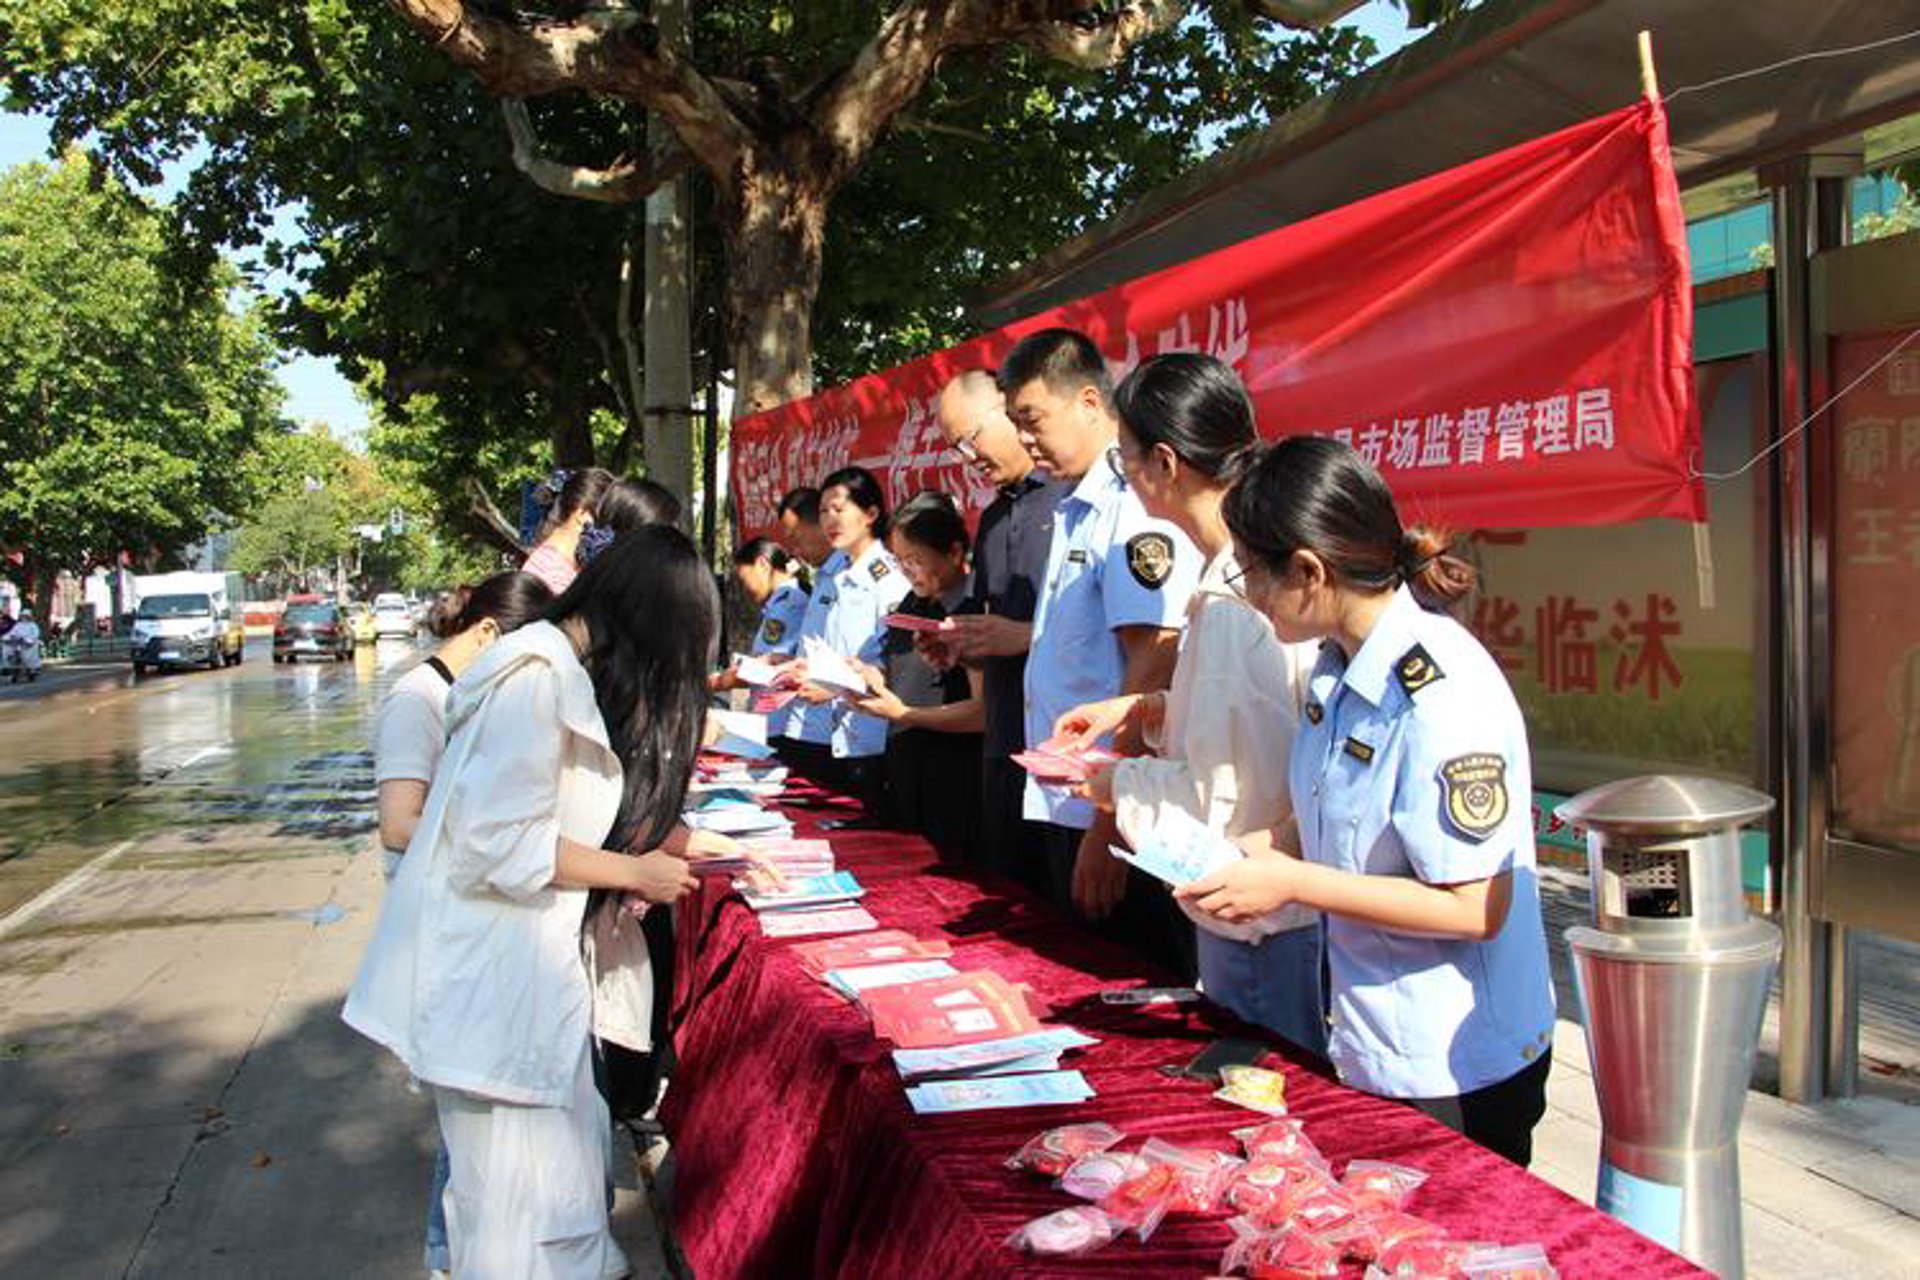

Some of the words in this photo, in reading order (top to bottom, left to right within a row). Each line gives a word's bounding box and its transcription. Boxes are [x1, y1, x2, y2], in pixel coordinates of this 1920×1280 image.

[1313, 387, 1615, 469] 市场监督管理局
